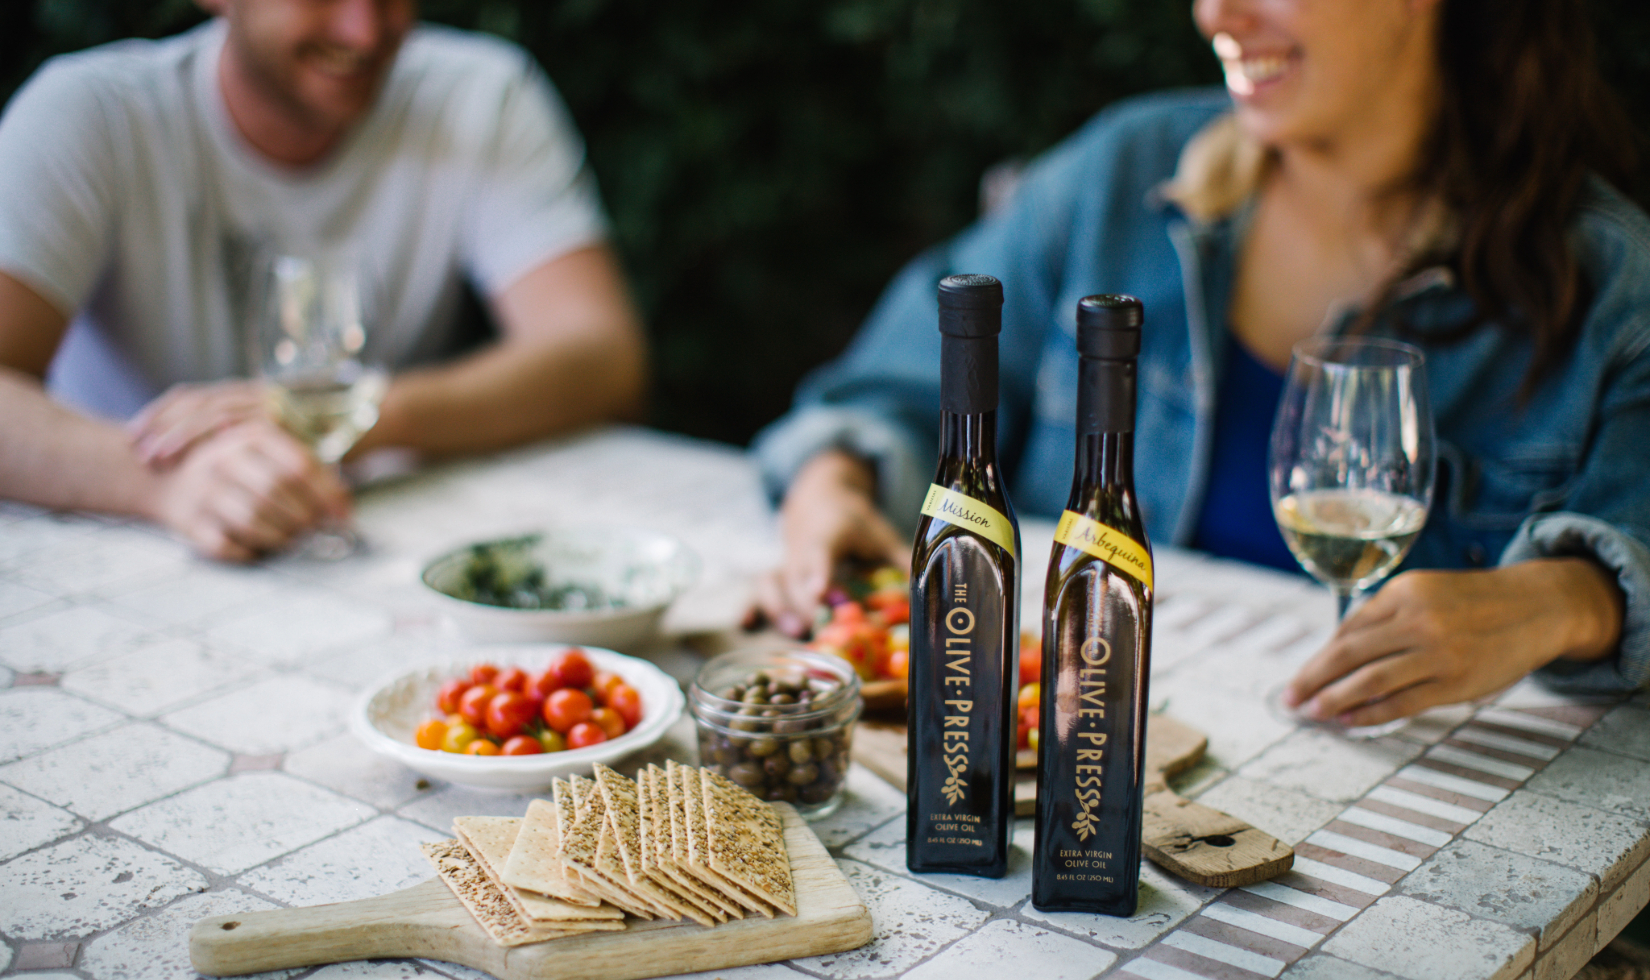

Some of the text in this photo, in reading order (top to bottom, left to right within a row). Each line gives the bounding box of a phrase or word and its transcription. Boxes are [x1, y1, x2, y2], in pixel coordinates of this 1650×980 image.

[937, 498, 991, 528] Mission
[1075, 527, 1146, 571] Arbequina
[955, 583, 967, 603] THE
[930, 813, 981, 823] EXTRA VIRGIN
[935, 823, 975, 832] OLIVE OIL
[1060, 849, 1112, 859] EXTRA VIRGIN
[1065, 860, 1106, 869] OLIVE OIL
